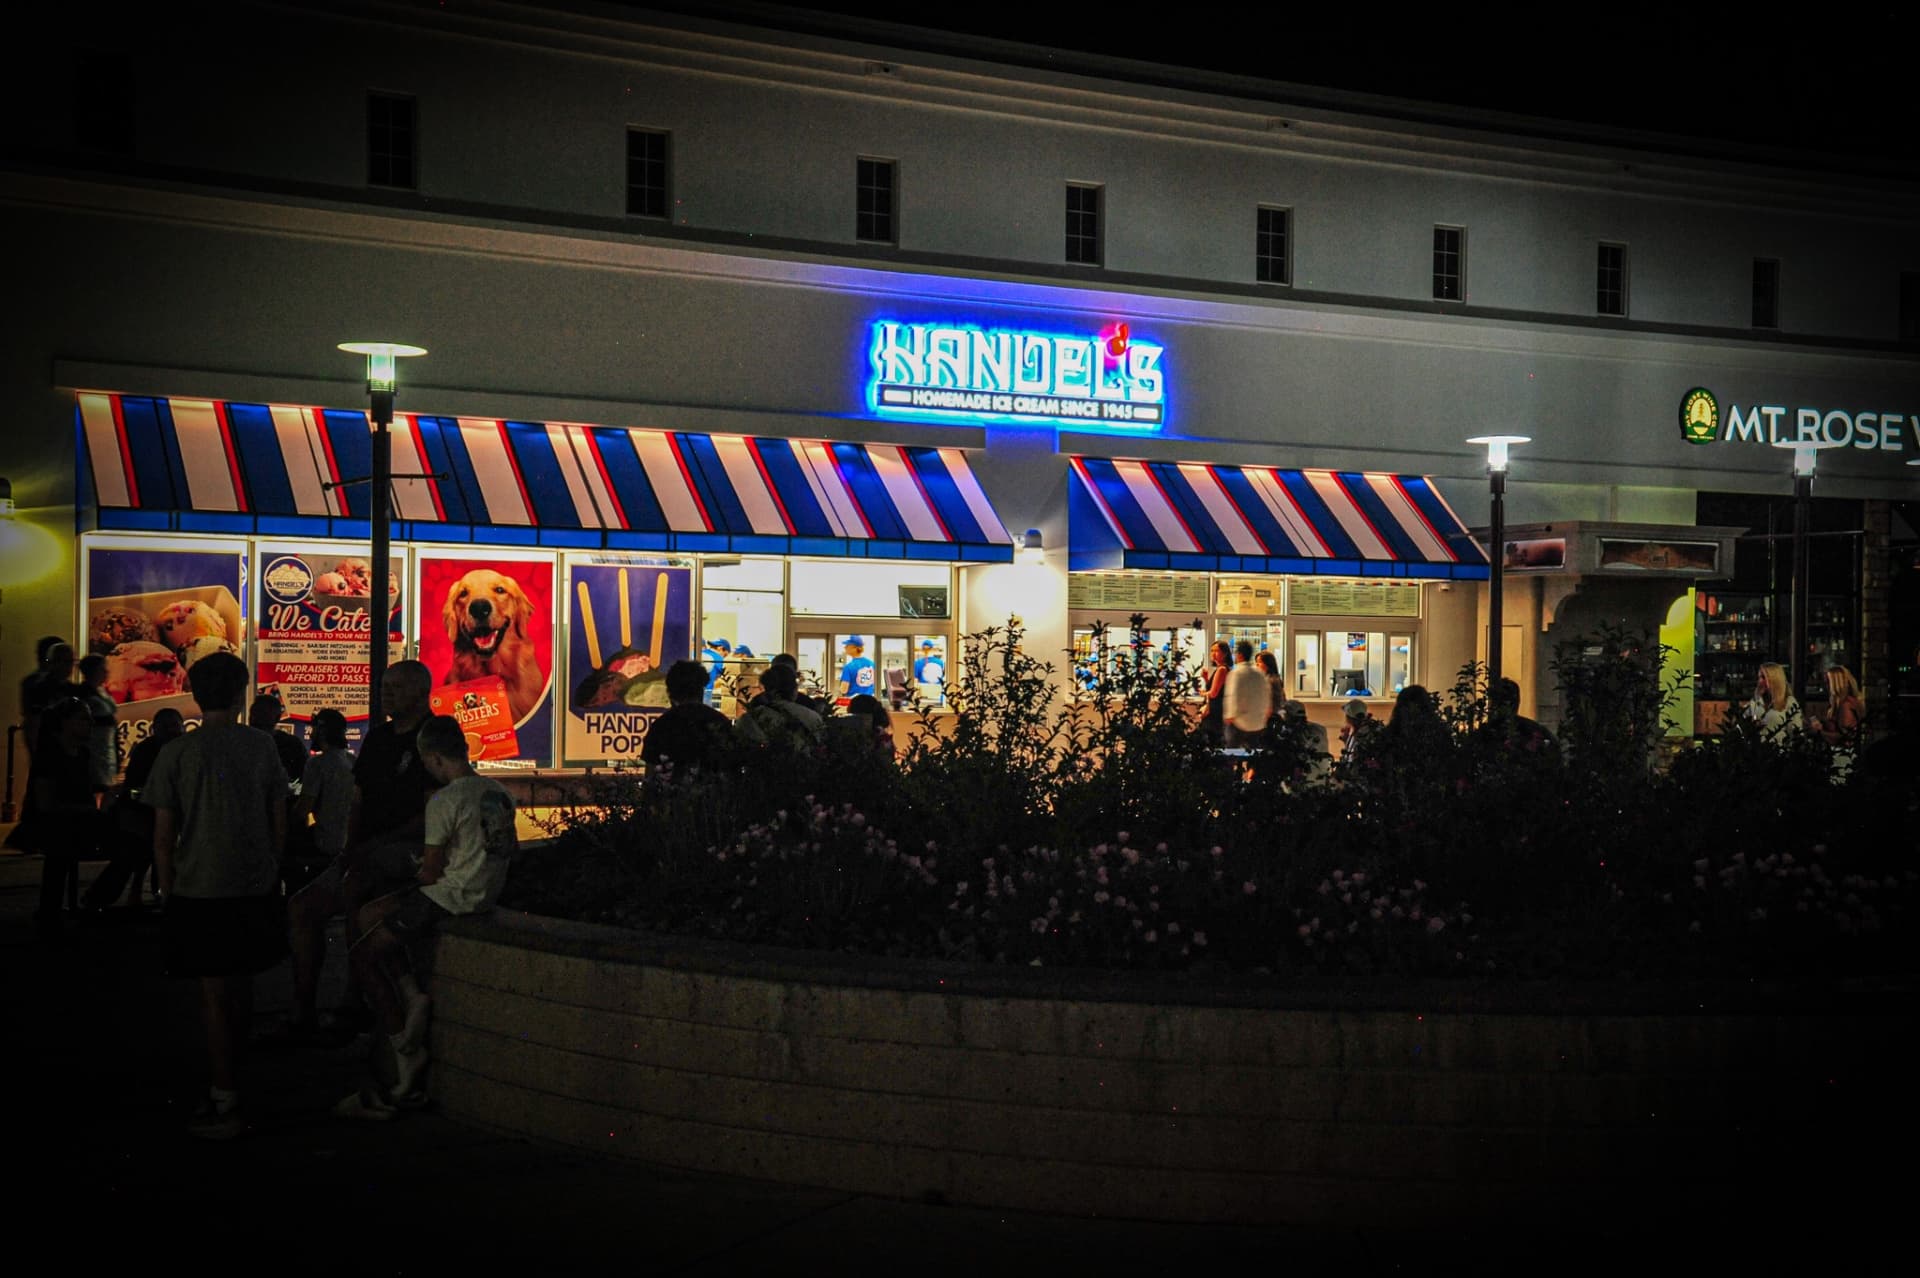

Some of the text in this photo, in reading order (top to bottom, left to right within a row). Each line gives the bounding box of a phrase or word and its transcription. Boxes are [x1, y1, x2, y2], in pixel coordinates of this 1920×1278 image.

[912, 389, 1133, 420] HOMEMADE ICE CREAM SINCE 1945
[1796, 408, 1904, 450] ROSE
[268, 603, 372, 632] We Cate
[275, 663, 339, 674] FUNDRAISERS
[340, 664, 362, 674] YOU
[286, 673, 326, 683] AFFORD
[327, 674, 340, 683] TO
[340, 674, 363, 683] PASS
